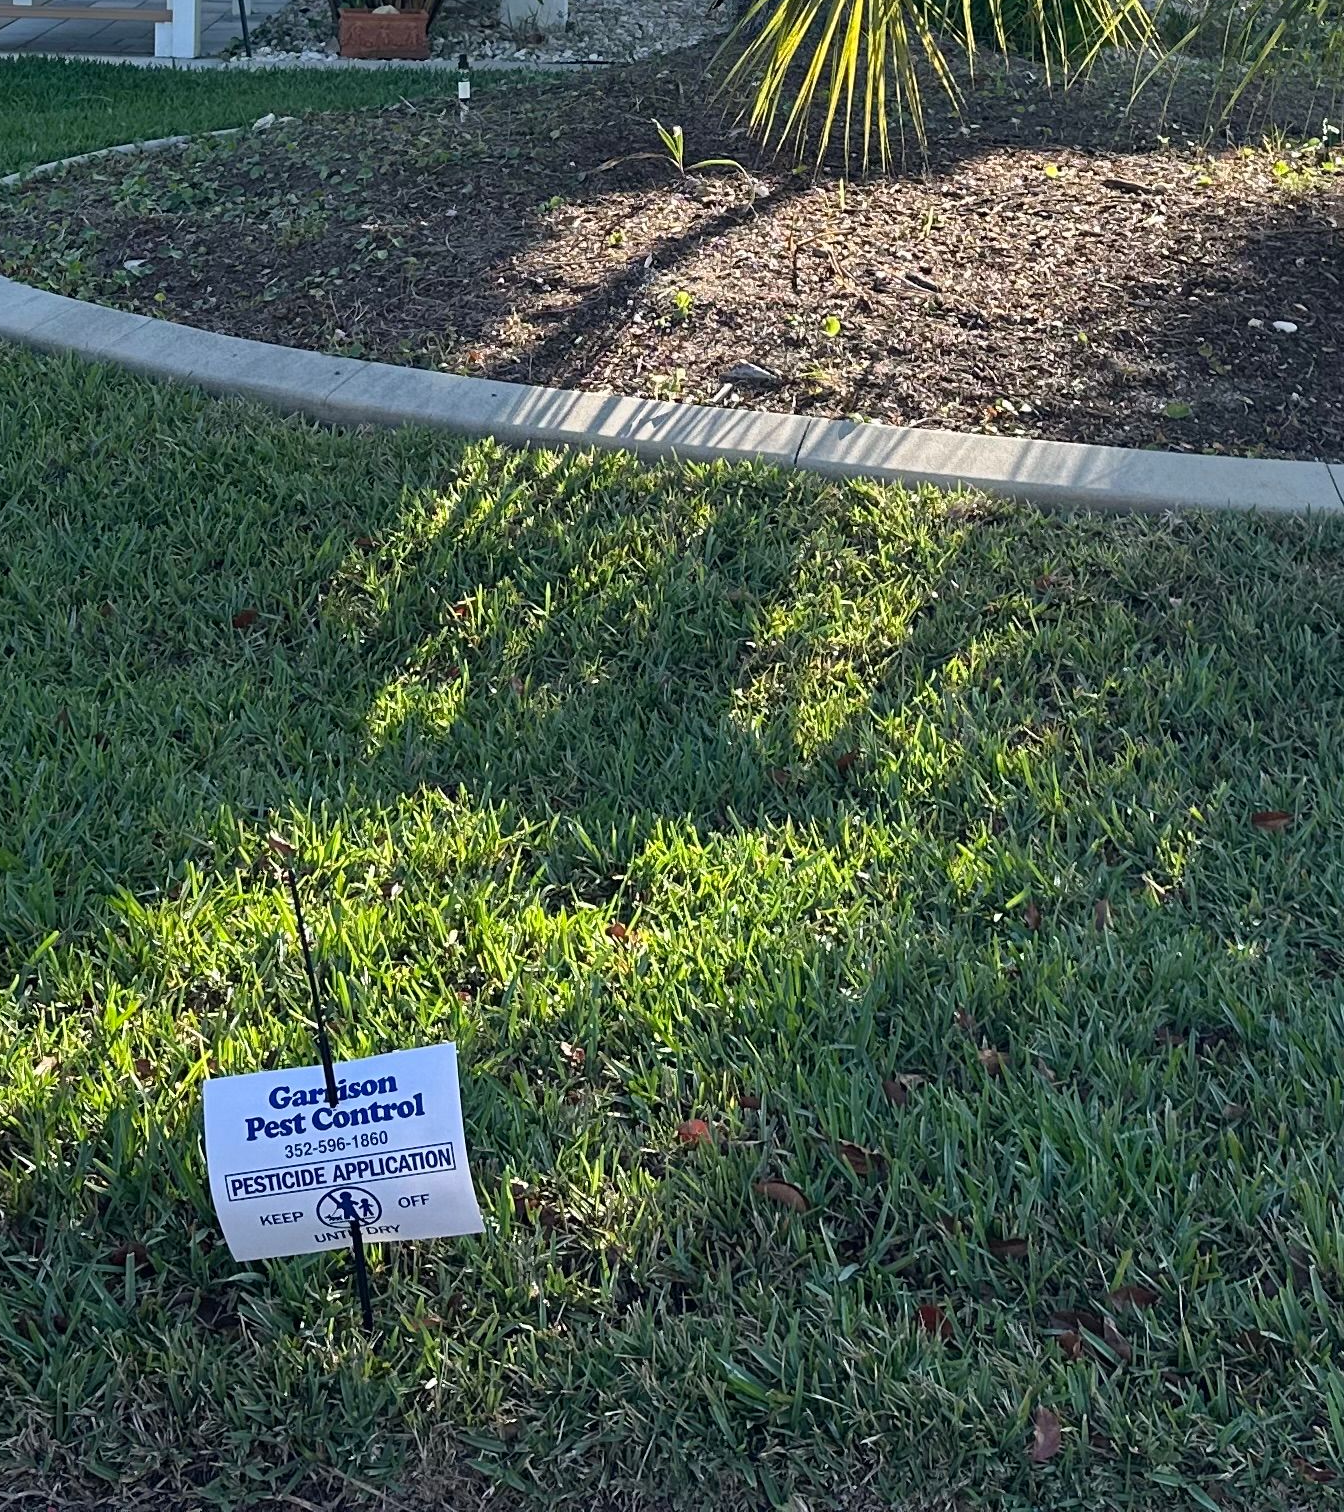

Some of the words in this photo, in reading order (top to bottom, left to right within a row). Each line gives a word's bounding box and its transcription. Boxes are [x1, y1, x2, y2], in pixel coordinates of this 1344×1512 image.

[245, 1113, 307, 1141] Pest
[311, 1092, 426, 1131] Control
[284, 1130, 389, 1159] 352-596-1860
[231, 1166, 327, 1197] PESTICIDE
[332, 1147, 453, 1183] APPLICATION
[259, 1210, 304, 1226] KEEP
[397, 1193, 430, 1209] OFF
[366, 1224, 401, 1235] DRY
